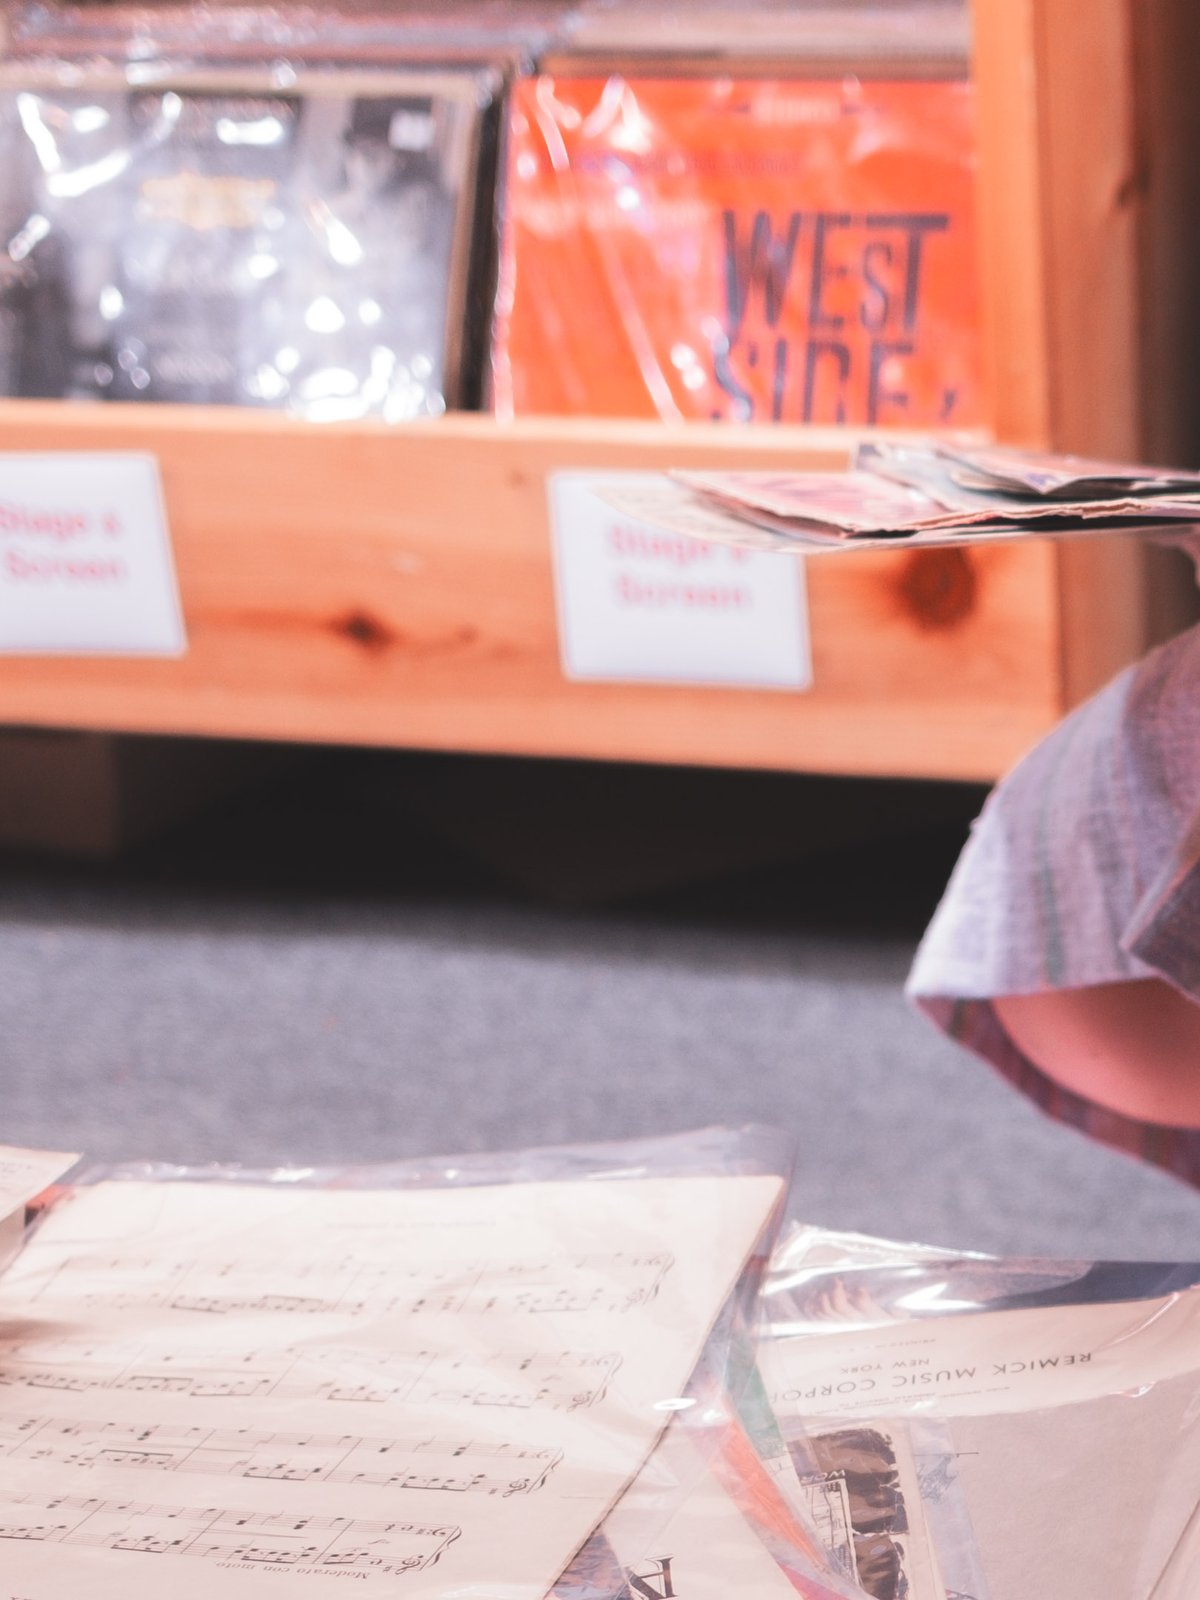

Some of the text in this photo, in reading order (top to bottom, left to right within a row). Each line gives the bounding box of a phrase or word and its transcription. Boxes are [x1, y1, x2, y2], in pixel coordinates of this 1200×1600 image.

[722, 209, 950, 336] WEST
[6, 551, 129, 584] Screen
[615, 573, 753, 611] Screen
[840, 1358, 930, 1375] NEW YORK
[992, 1352, 1092, 1376] REMICK
[891, 1367, 976, 1387] MUSIC
[215, 1561, 371, 1580] Moderato con moto
